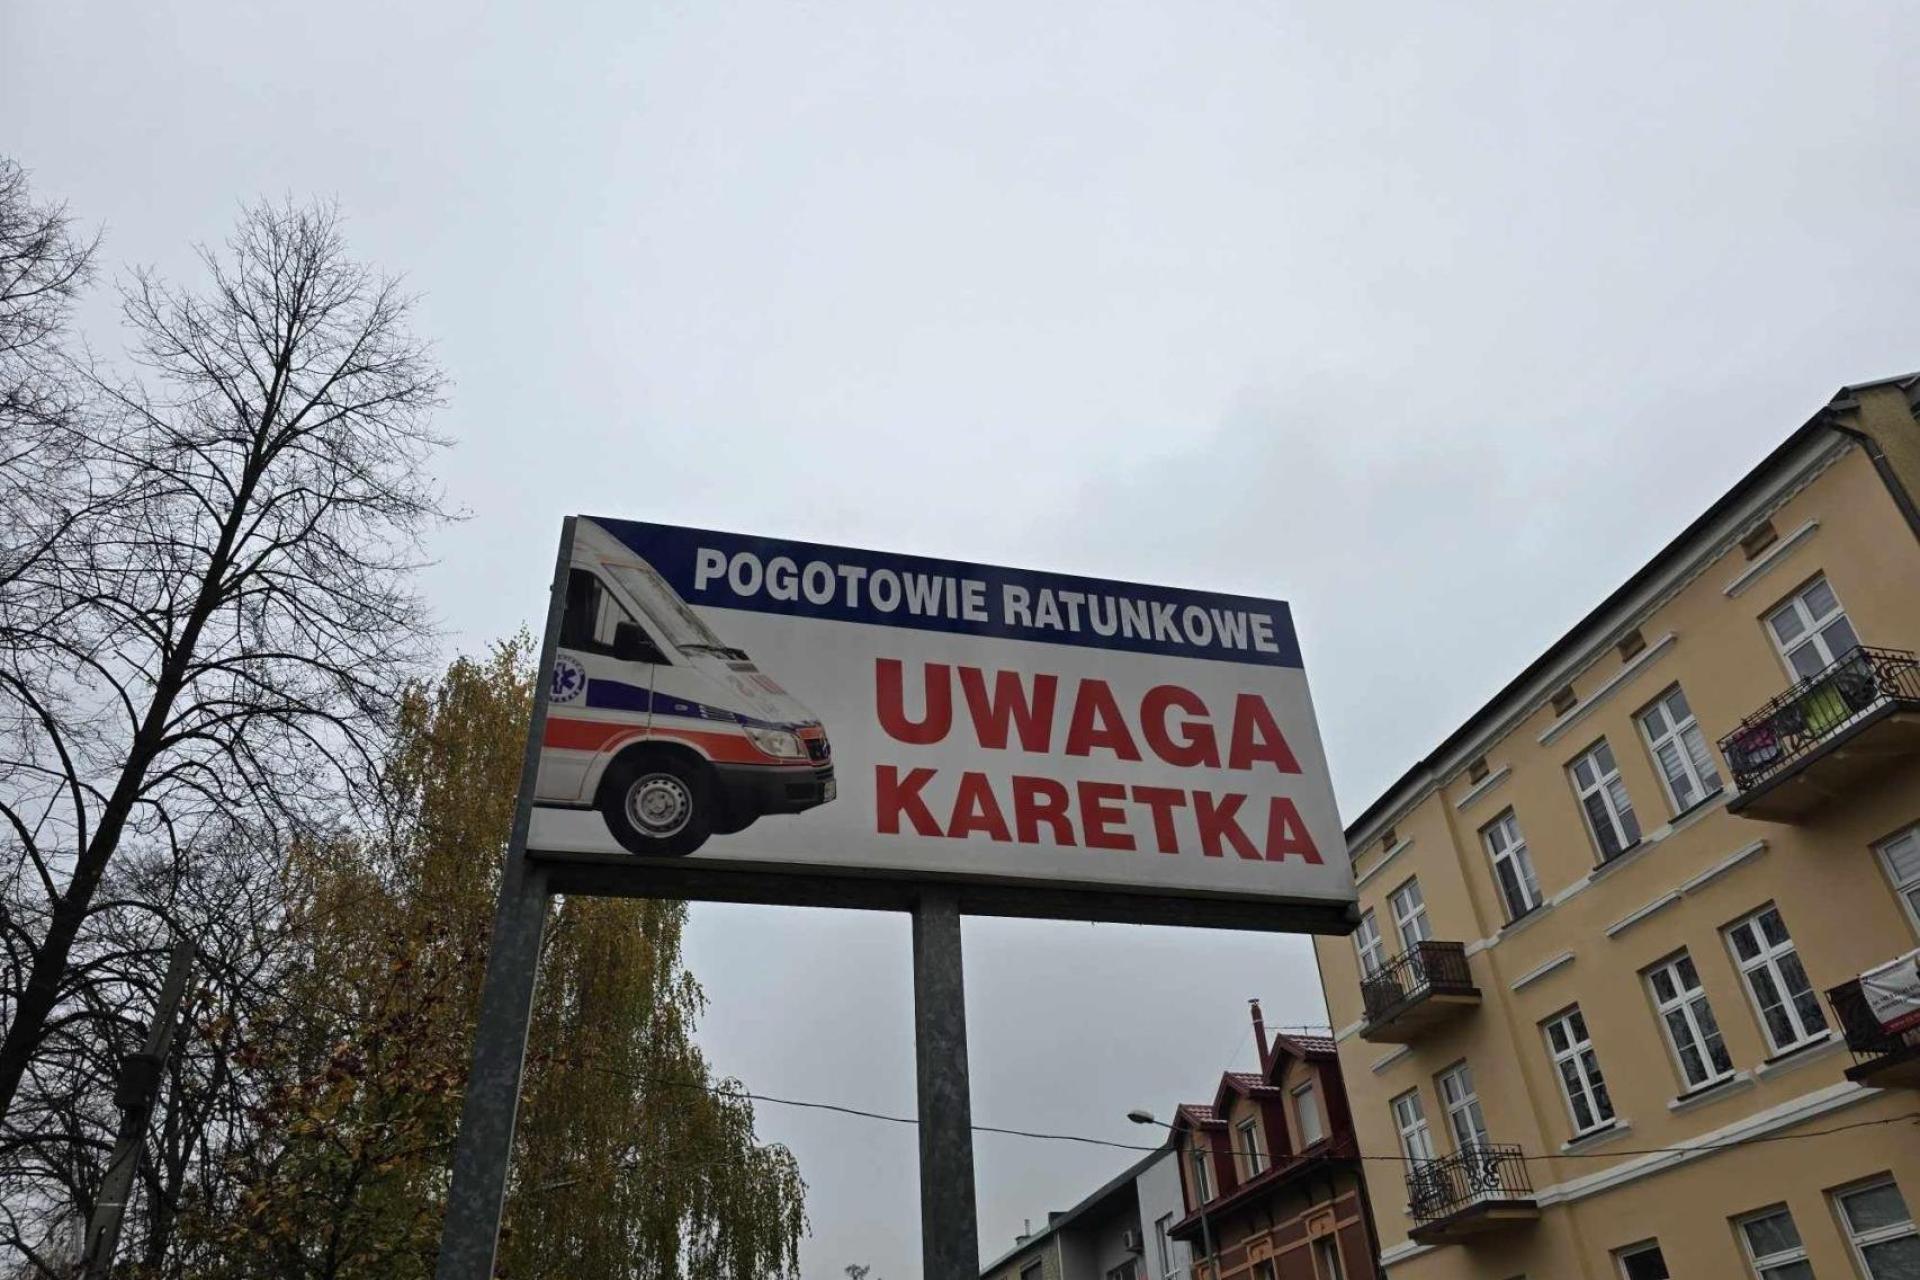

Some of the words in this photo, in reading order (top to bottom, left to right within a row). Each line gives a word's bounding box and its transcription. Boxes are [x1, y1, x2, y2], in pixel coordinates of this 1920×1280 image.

[694, 547, 988, 622] POGOTOWIE
[1003, 584, 1279, 653] RATUNKOWE
[875, 658, 1302, 774] UWAGA
[875, 765, 1324, 865] KARETKA
